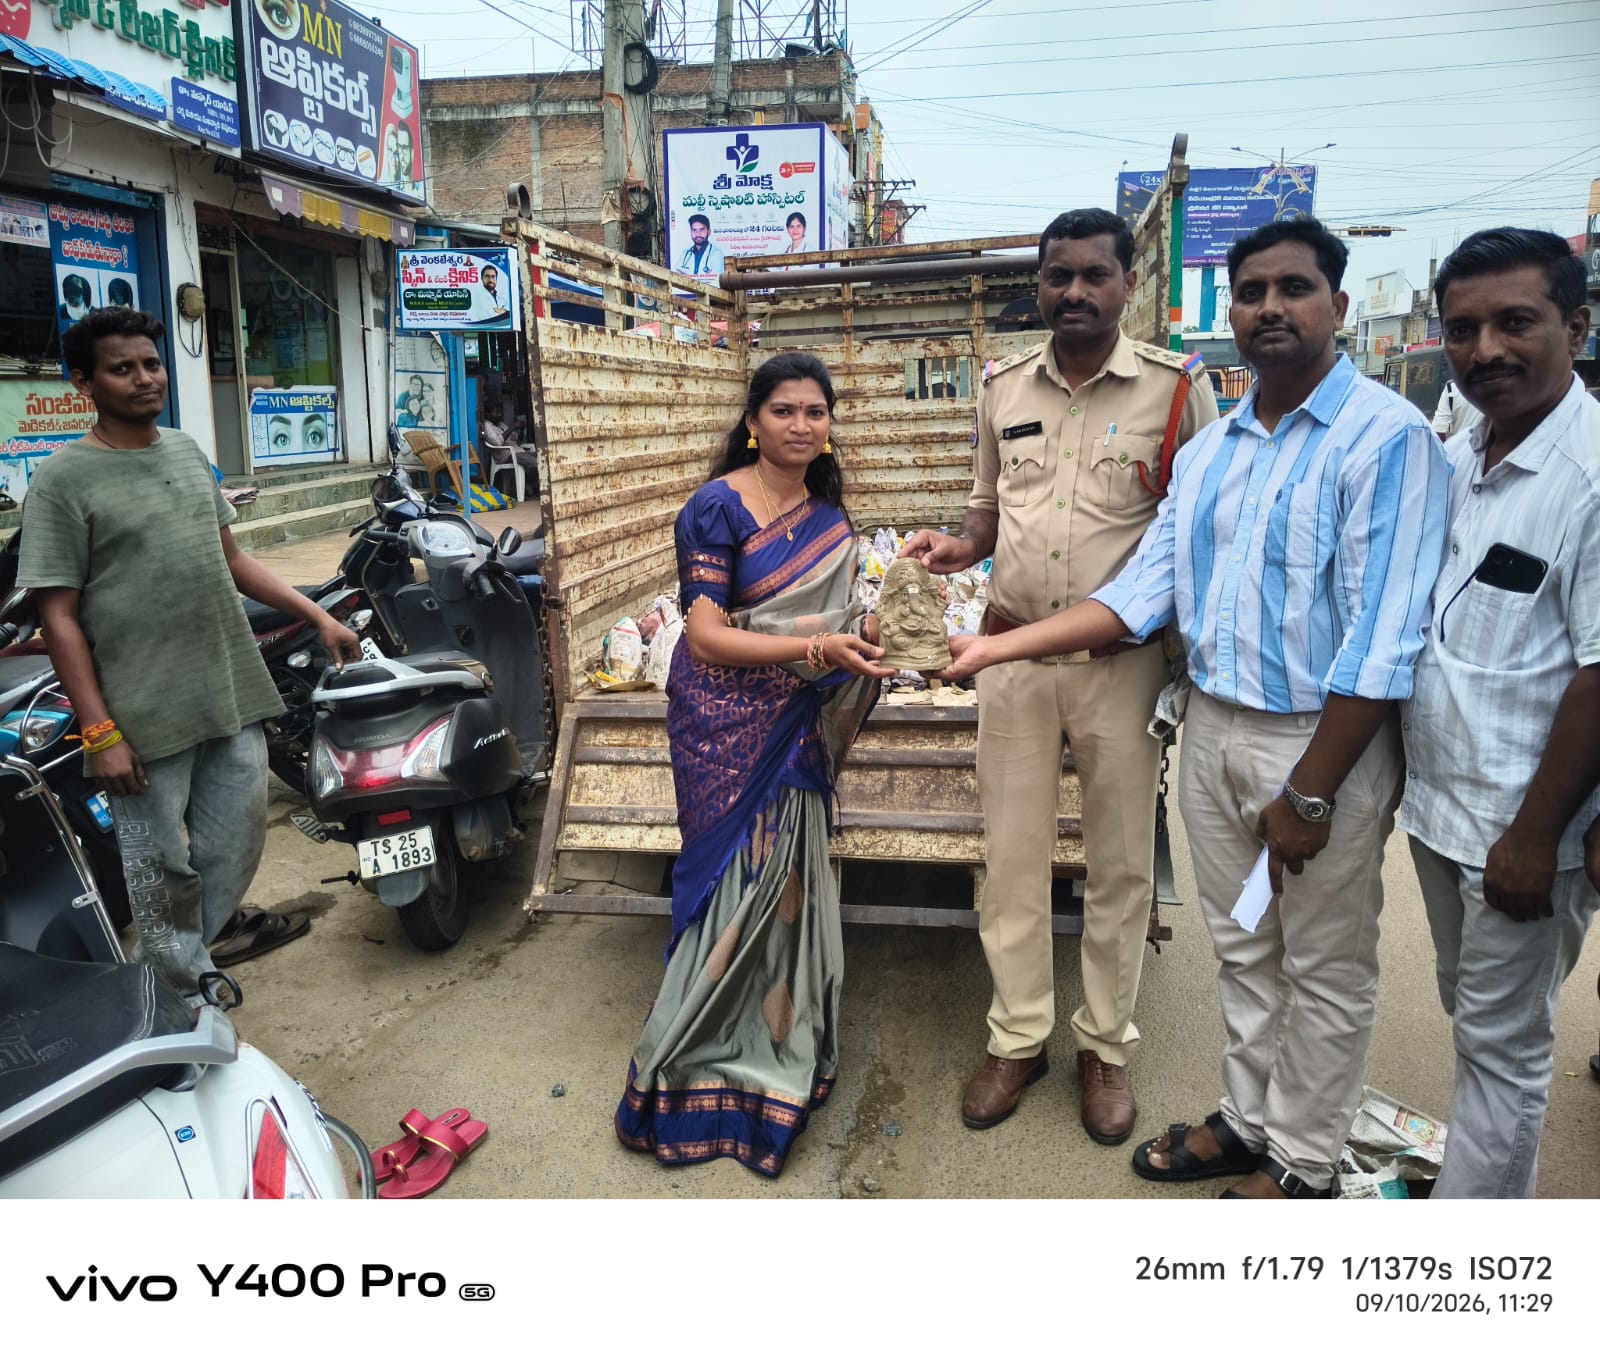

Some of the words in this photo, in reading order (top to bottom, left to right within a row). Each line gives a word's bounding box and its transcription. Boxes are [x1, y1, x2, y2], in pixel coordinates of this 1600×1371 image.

[300, 3, 342, 59] MN
[185, 18, 238, 81] క్లినిక్
[260, 37, 377, 138] ఆప్టికల్స్
[712, 173, 731, 190] శ్రీ
[735, 173, 774, 190] మోక్ష
[682, 192, 706, 211] మల్టీ
[708, 191, 755, 210] స్పెషాలిటీ
[757, 190, 806, 209] హాస్పిటల్
[749, 224, 760, 233] 24
[409, 254, 419, 267] శ్రీ
[420, 254, 464, 268] వెంకటేశ్వర
[401, 267, 426, 287] స్కిన్
[448, 267, 479, 288] క్లినిక్
[268, 396, 289, 408] MN
[370, 839, 392, 857] TS
[398, 832, 418, 851] 25
[372, 858, 381, 875] A
[392, 846, 432, 870] 1893
